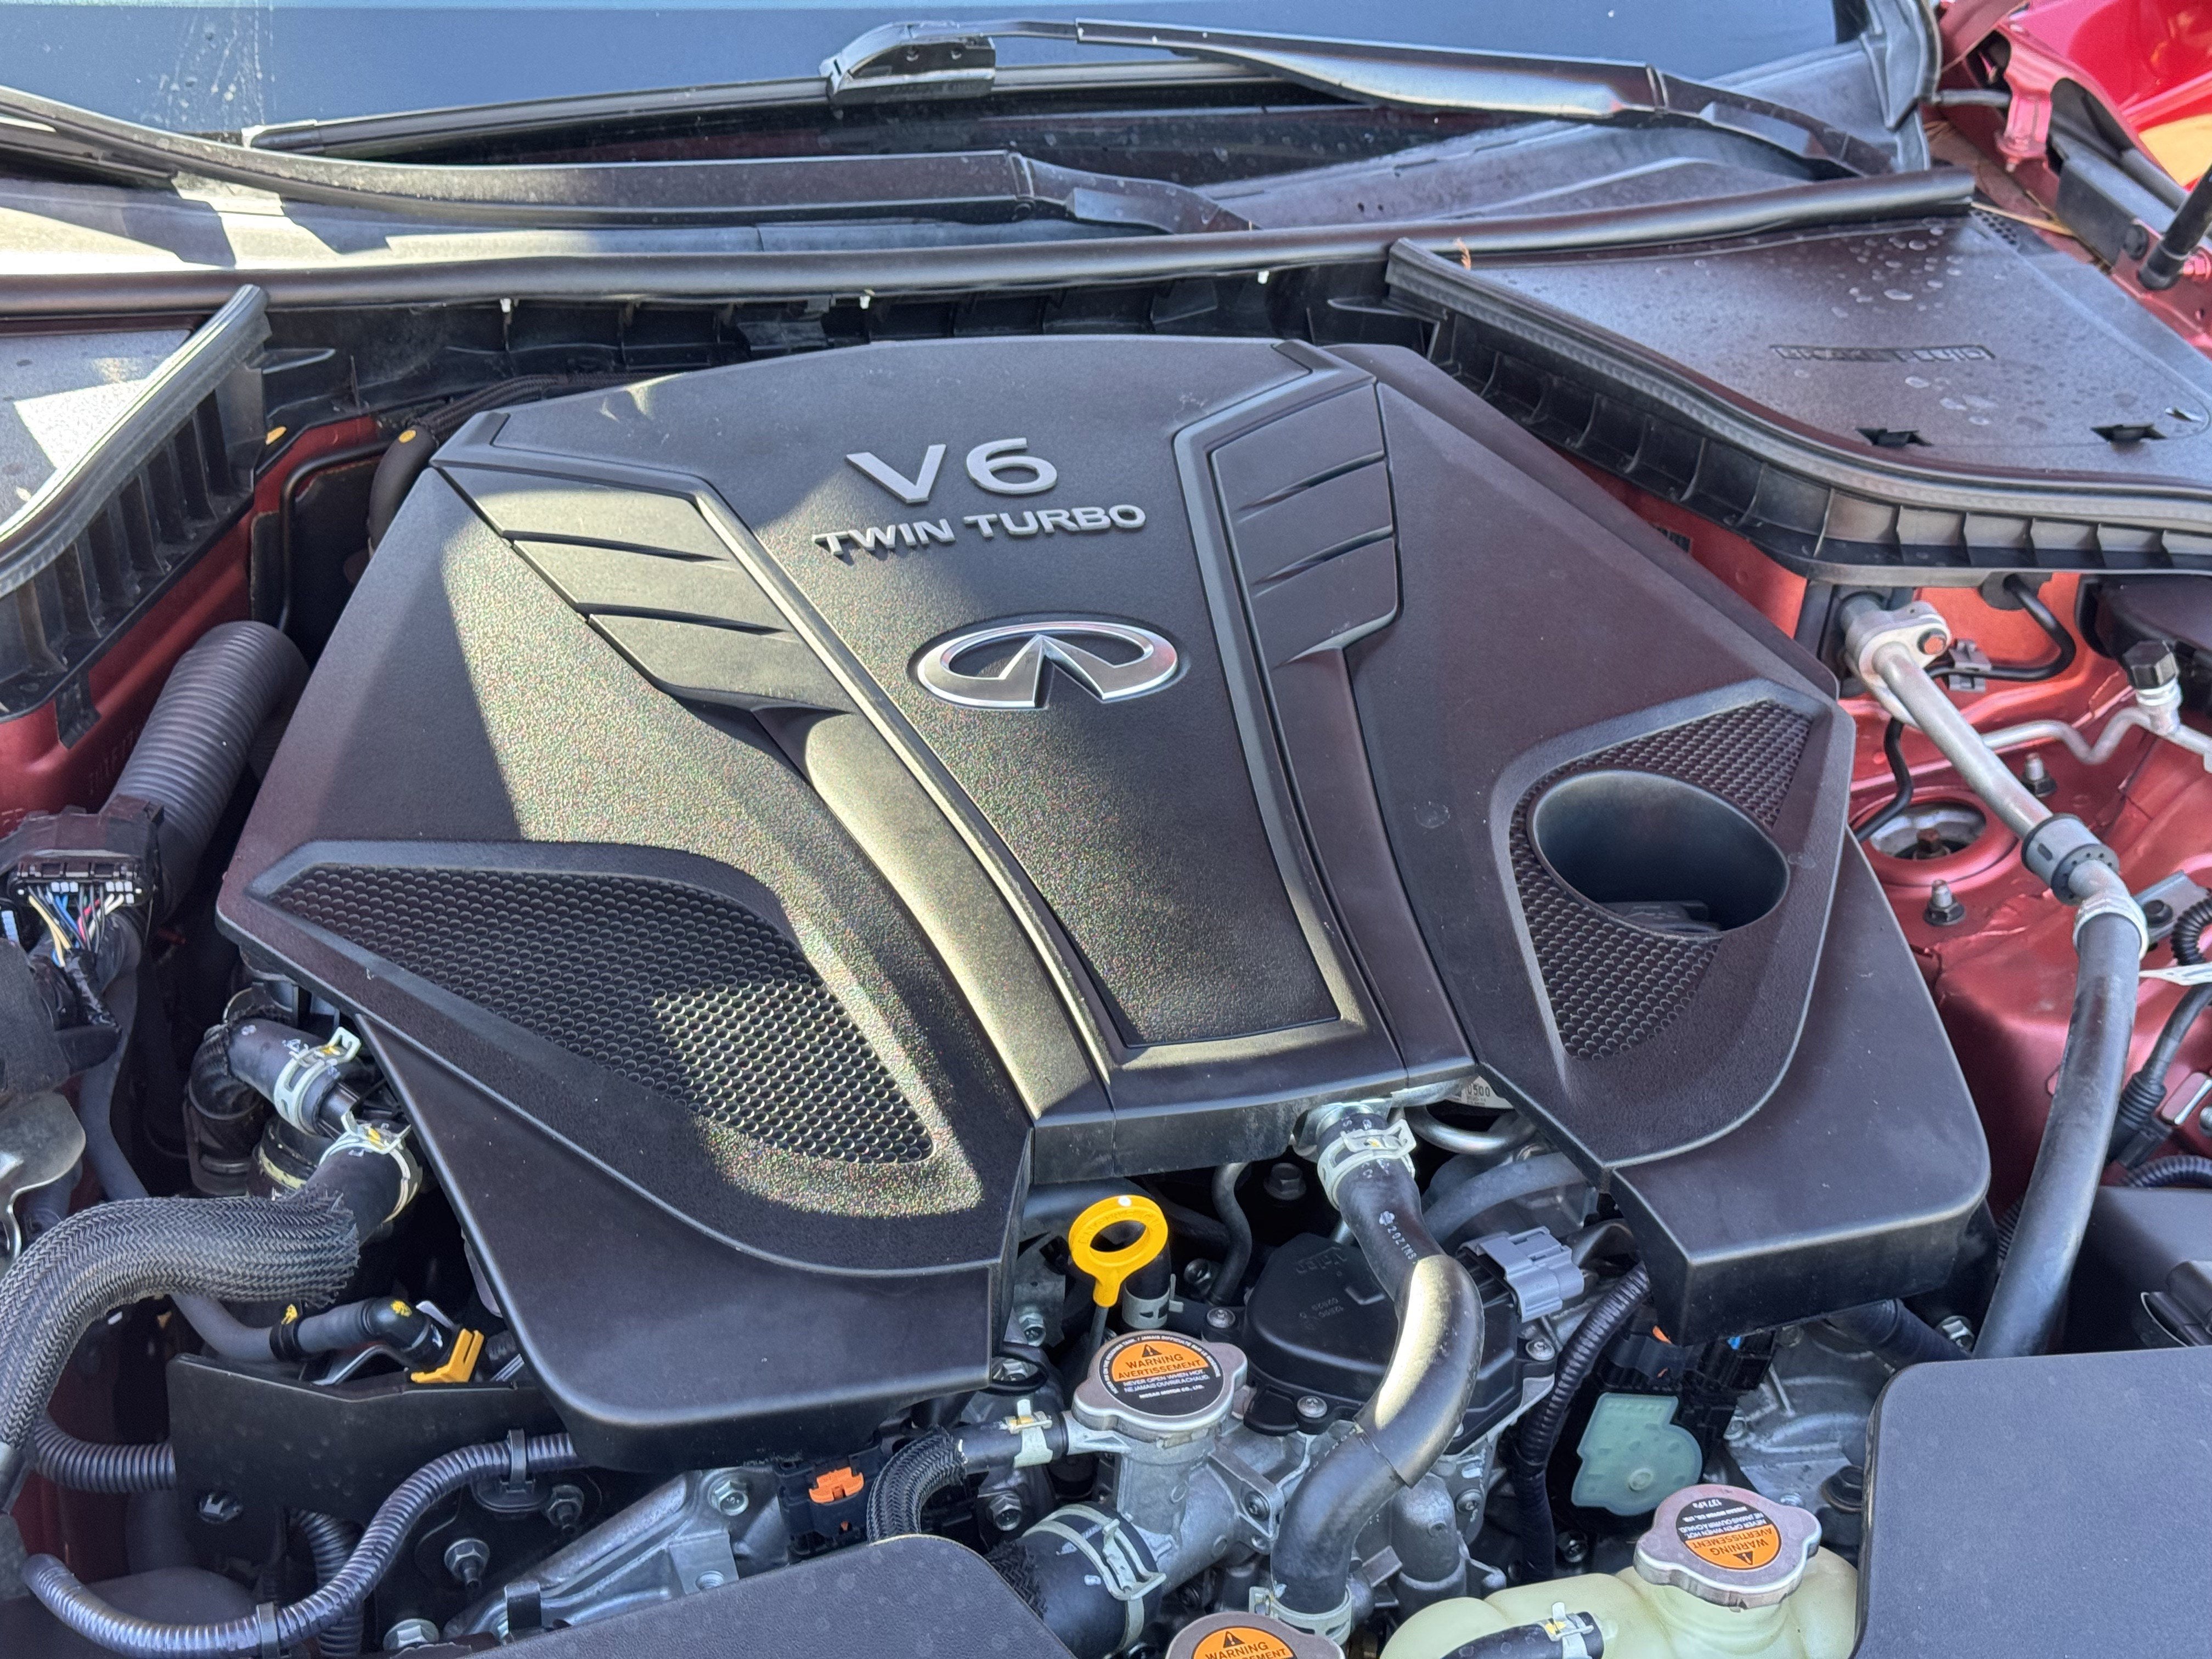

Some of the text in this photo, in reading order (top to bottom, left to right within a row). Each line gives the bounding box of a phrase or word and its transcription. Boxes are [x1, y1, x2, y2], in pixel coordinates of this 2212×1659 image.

[845, 437, 1058, 504] V6
[812, 504, 1146, 557] TWIN TURBO
[1118, 1359, 1201, 1379] AVERTISSEMENT
[1125, 1353, 1184, 1369] WARNING
[1122, 1379, 1147, 1387] NEVER
[1133, 1383, 1156, 1392] JAMAIS
[1708, 1498, 1723, 1508] 137
[1723, 1523, 1743, 1532] OPEN
[1743, 1519, 1767, 1528] NEVER
[1692, 1527, 1773, 1549] AVERTISSEMENT
[1709, 1538, 1769, 1556] WARNING
[1205, 1641, 1269, 1659] WARNING
